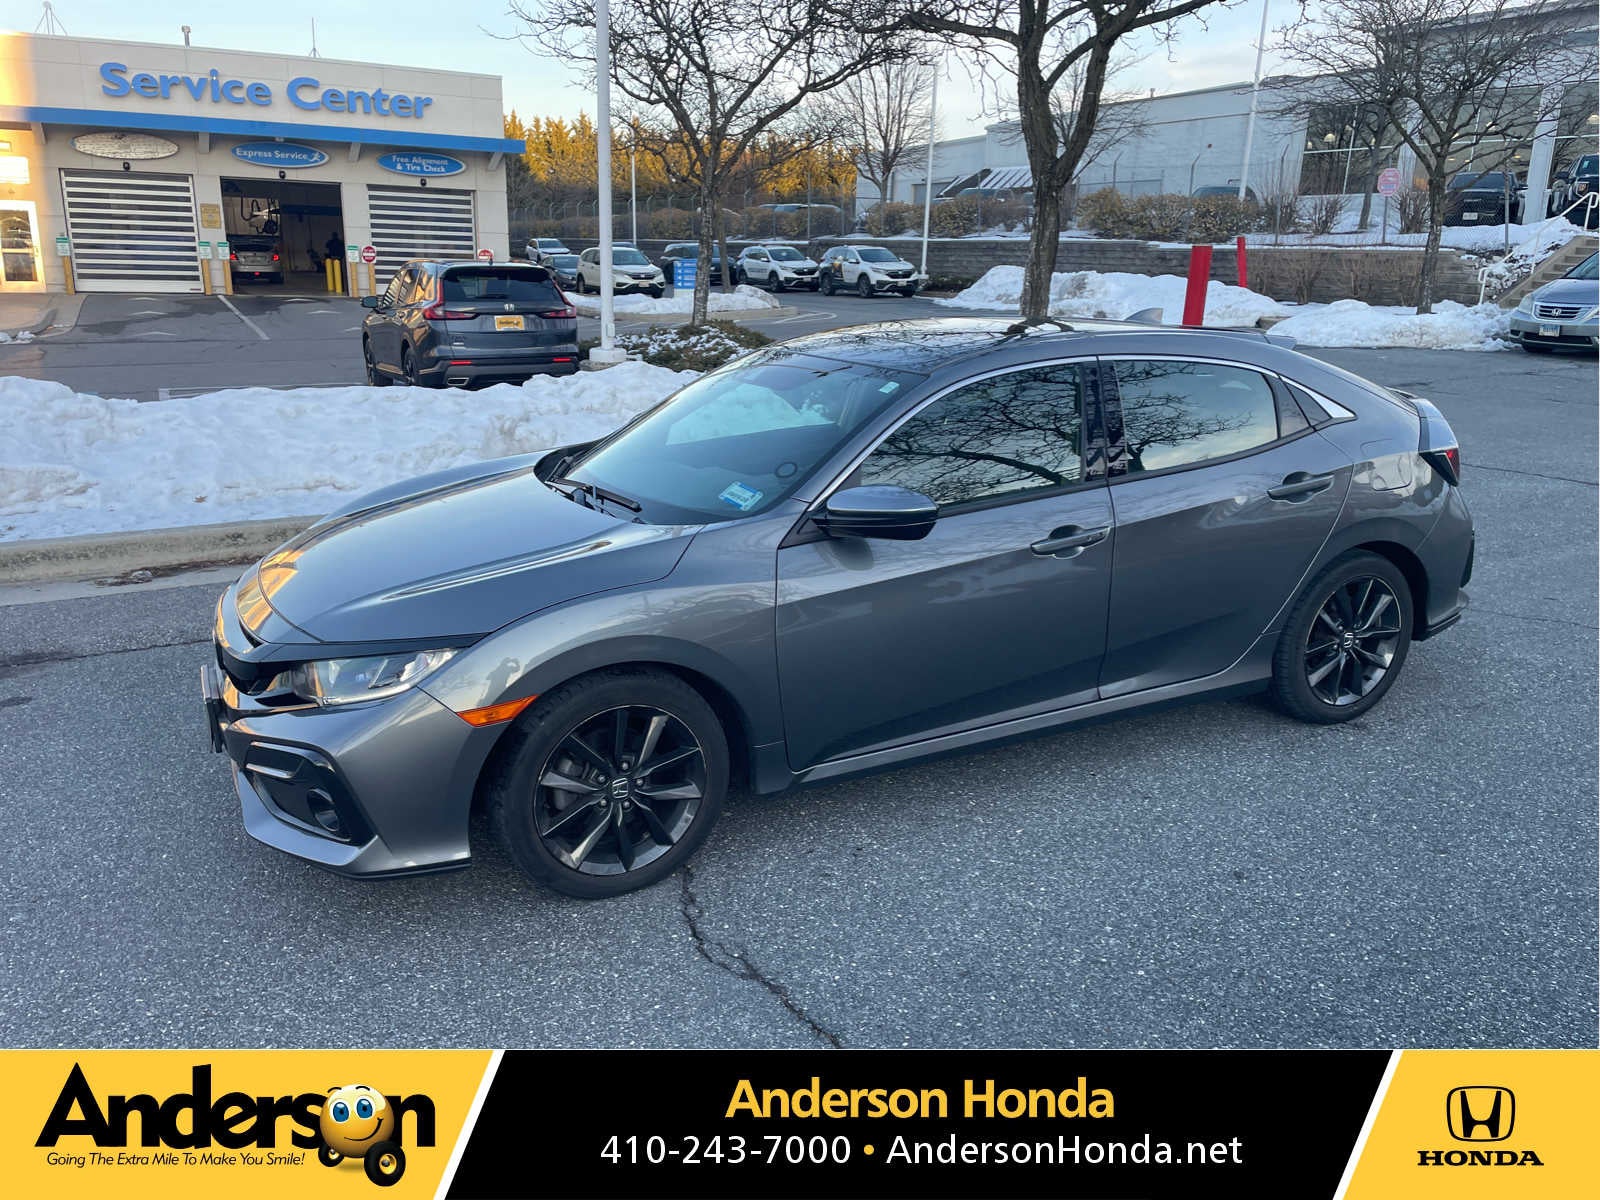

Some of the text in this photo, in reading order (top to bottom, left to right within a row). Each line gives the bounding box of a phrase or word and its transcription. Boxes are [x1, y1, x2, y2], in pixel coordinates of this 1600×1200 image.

[100, 62, 433, 118] Service Center
[235, 143, 308, 160] Express Service
